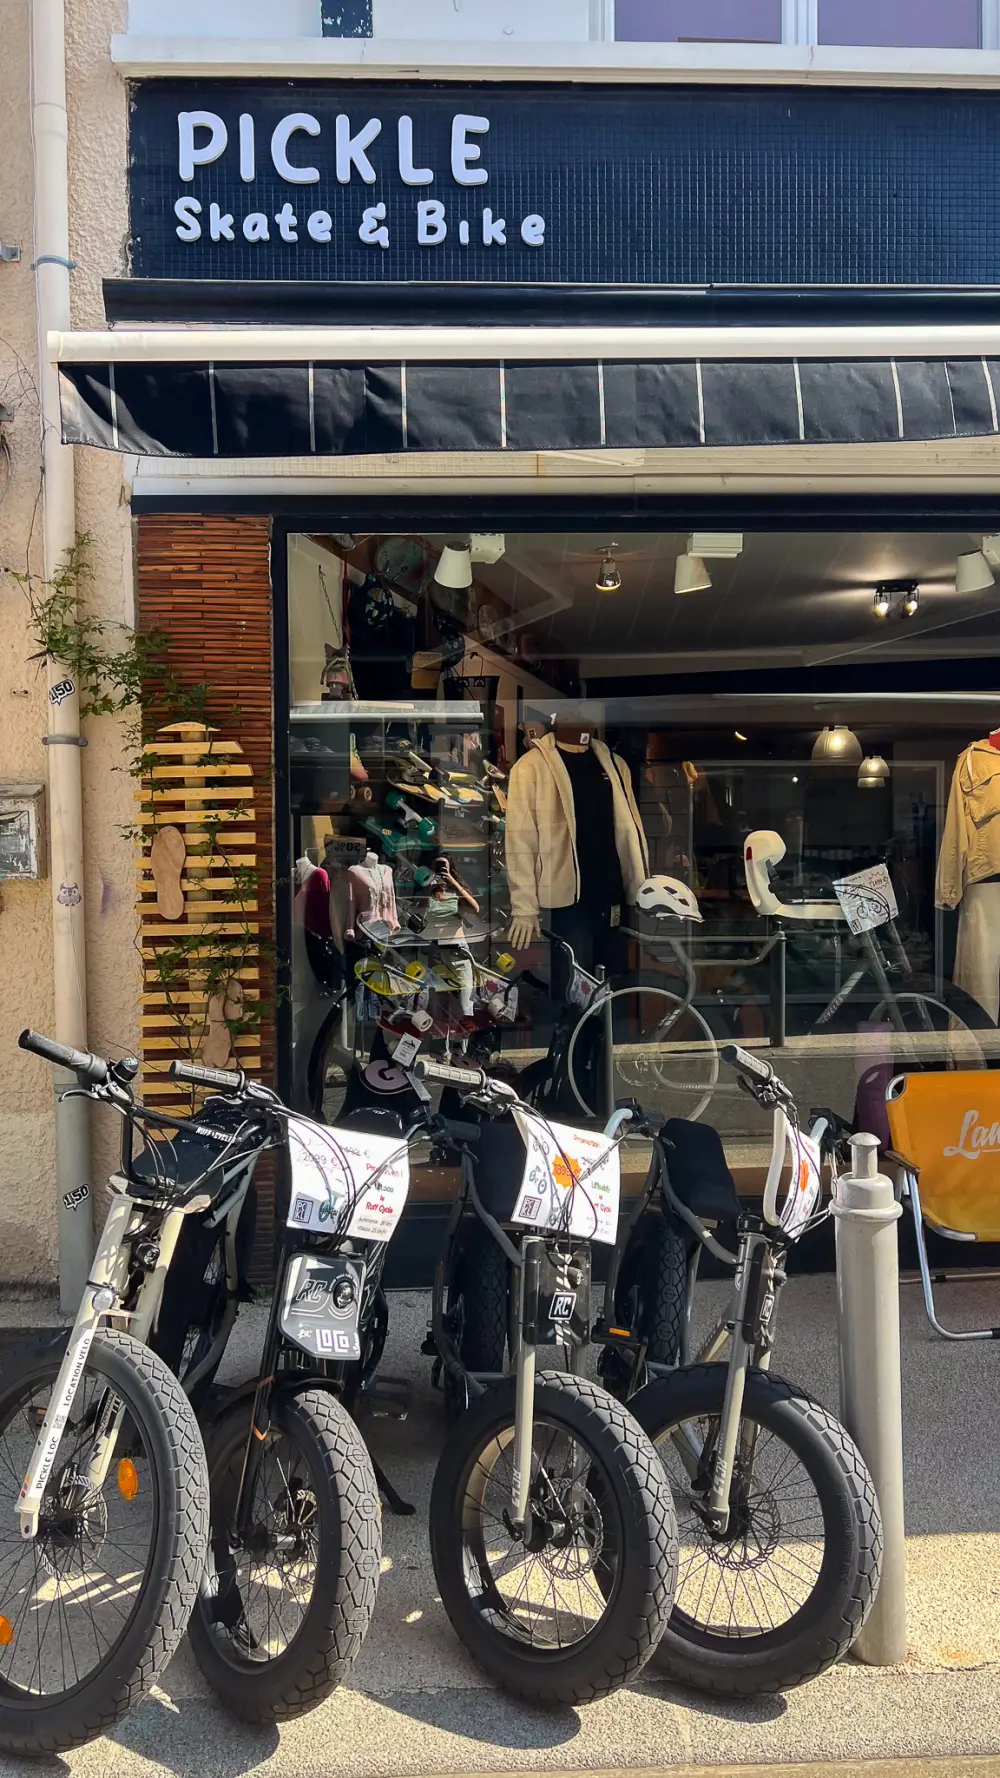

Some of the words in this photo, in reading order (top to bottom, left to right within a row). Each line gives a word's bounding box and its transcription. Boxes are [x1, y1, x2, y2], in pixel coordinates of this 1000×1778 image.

[178, 110, 490, 186] PICKLE
[174, 196, 333, 243] Skate
[358, 202, 389, 249] &
[417, 200, 546, 247] Bike
[296, 1279, 328, 1303] RC
[553, 1296, 572, 1316] RC
[63, 1362, 83, 1407] LOCATION
[36, 1456, 52, 1490] PICKLE
[49, 1436, 59, 1456] LOC
